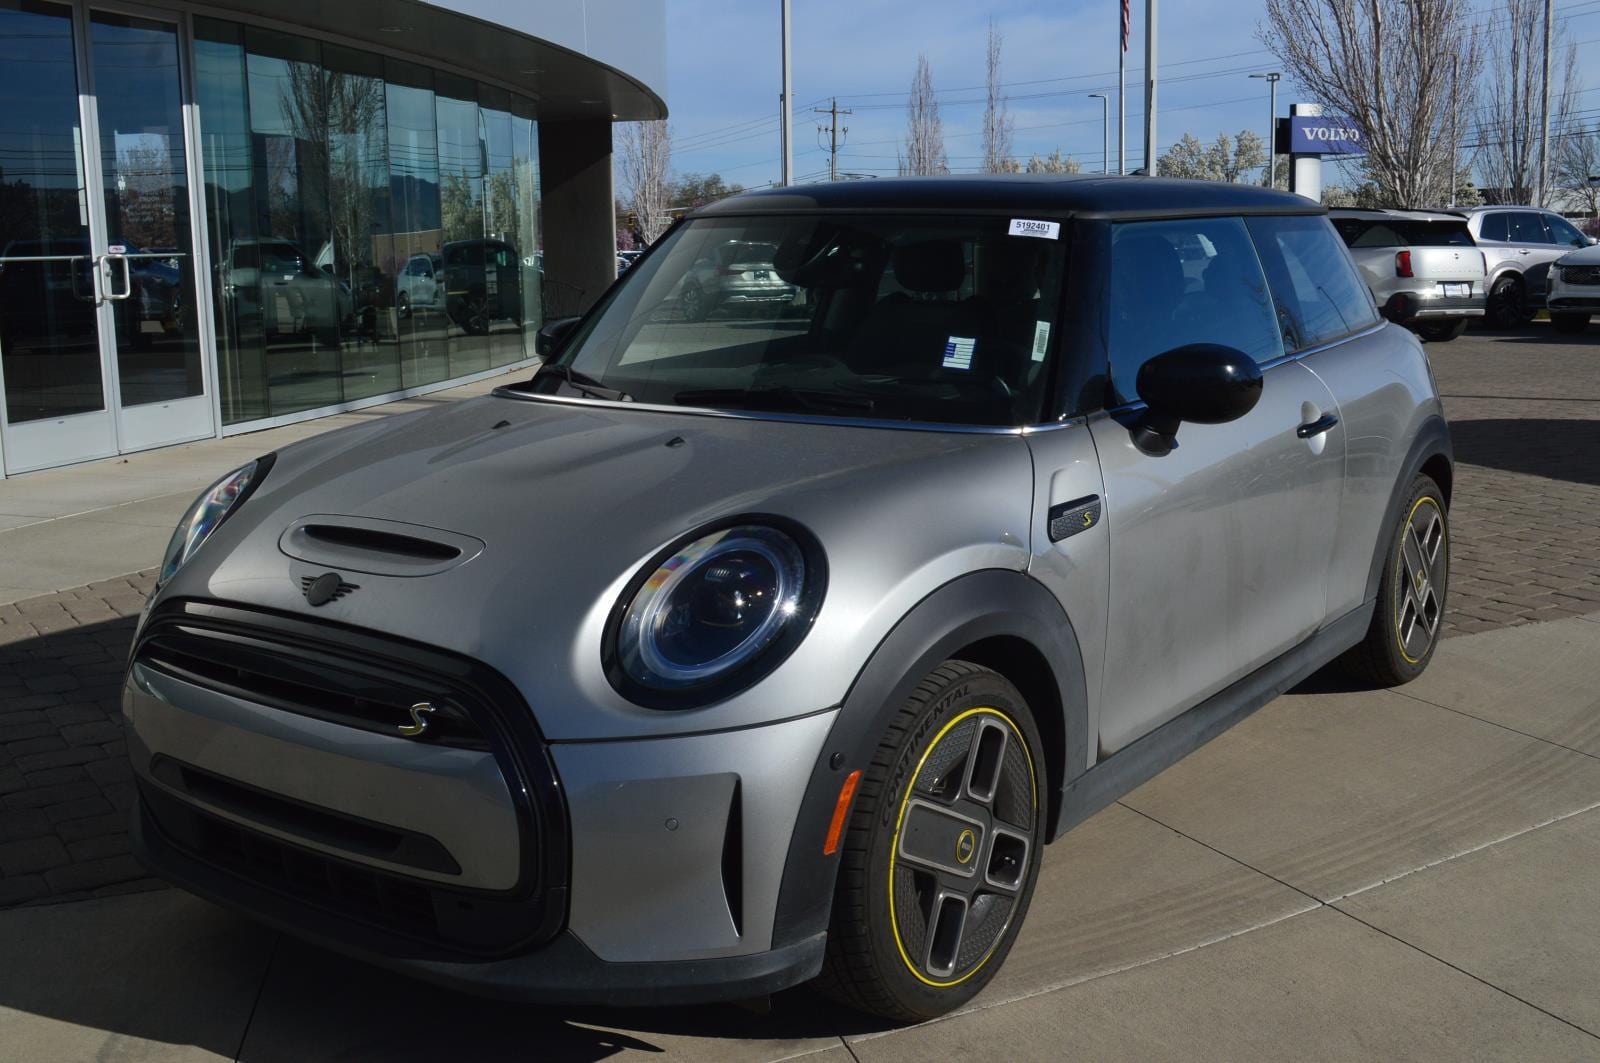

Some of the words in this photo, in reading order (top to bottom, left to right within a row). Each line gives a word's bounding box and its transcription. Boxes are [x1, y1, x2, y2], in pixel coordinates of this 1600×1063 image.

[1302, 127, 1360, 141] VOLVO
[1083, 511, 1092, 526] S
[398, 702, 436, 736] S
[882, 684, 971, 828] CONTINENTAL
